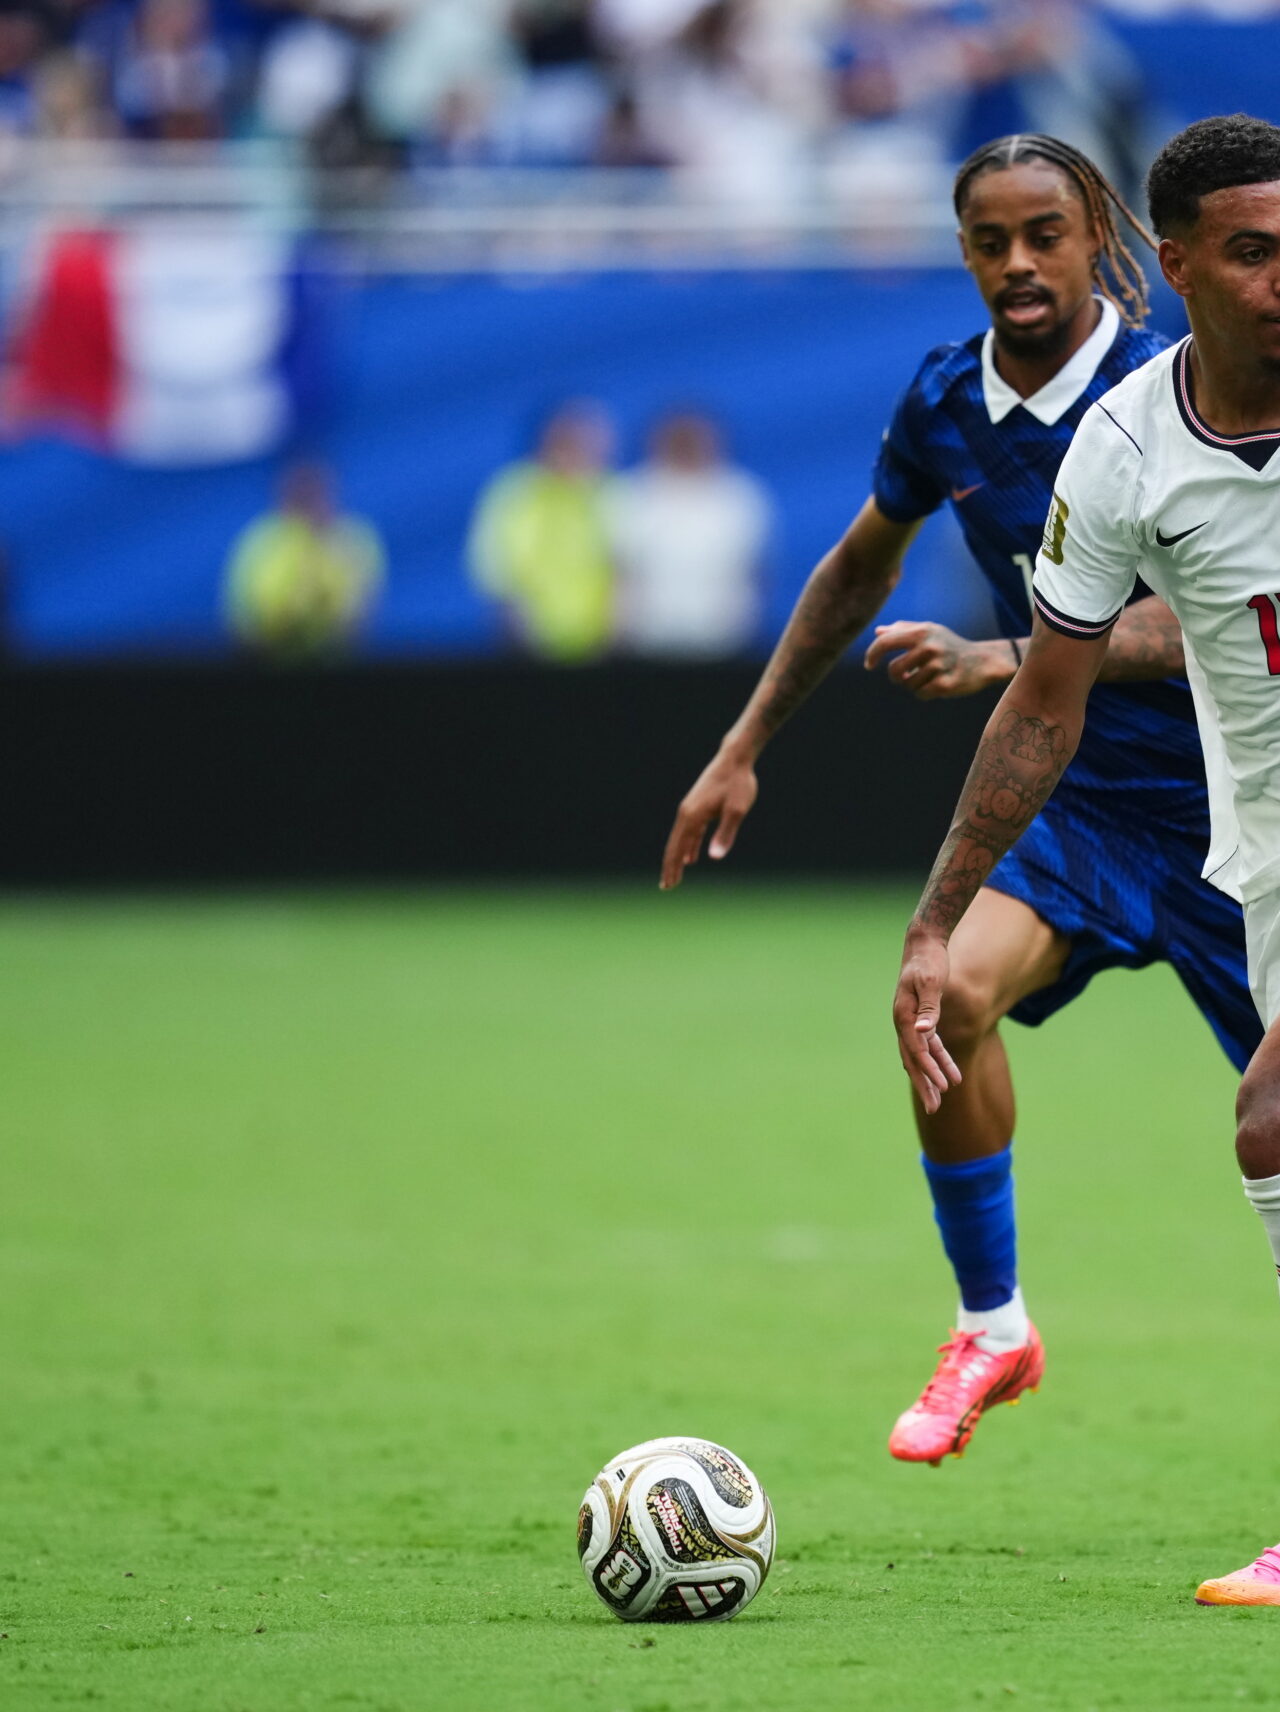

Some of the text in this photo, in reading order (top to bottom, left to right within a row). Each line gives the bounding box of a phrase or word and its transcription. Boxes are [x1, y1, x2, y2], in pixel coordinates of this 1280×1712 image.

[652, 1495, 683, 1556] TRIONDA
[660, 1490, 683, 1531] FINAL
[622, 1557, 635, 1572] FIFA
